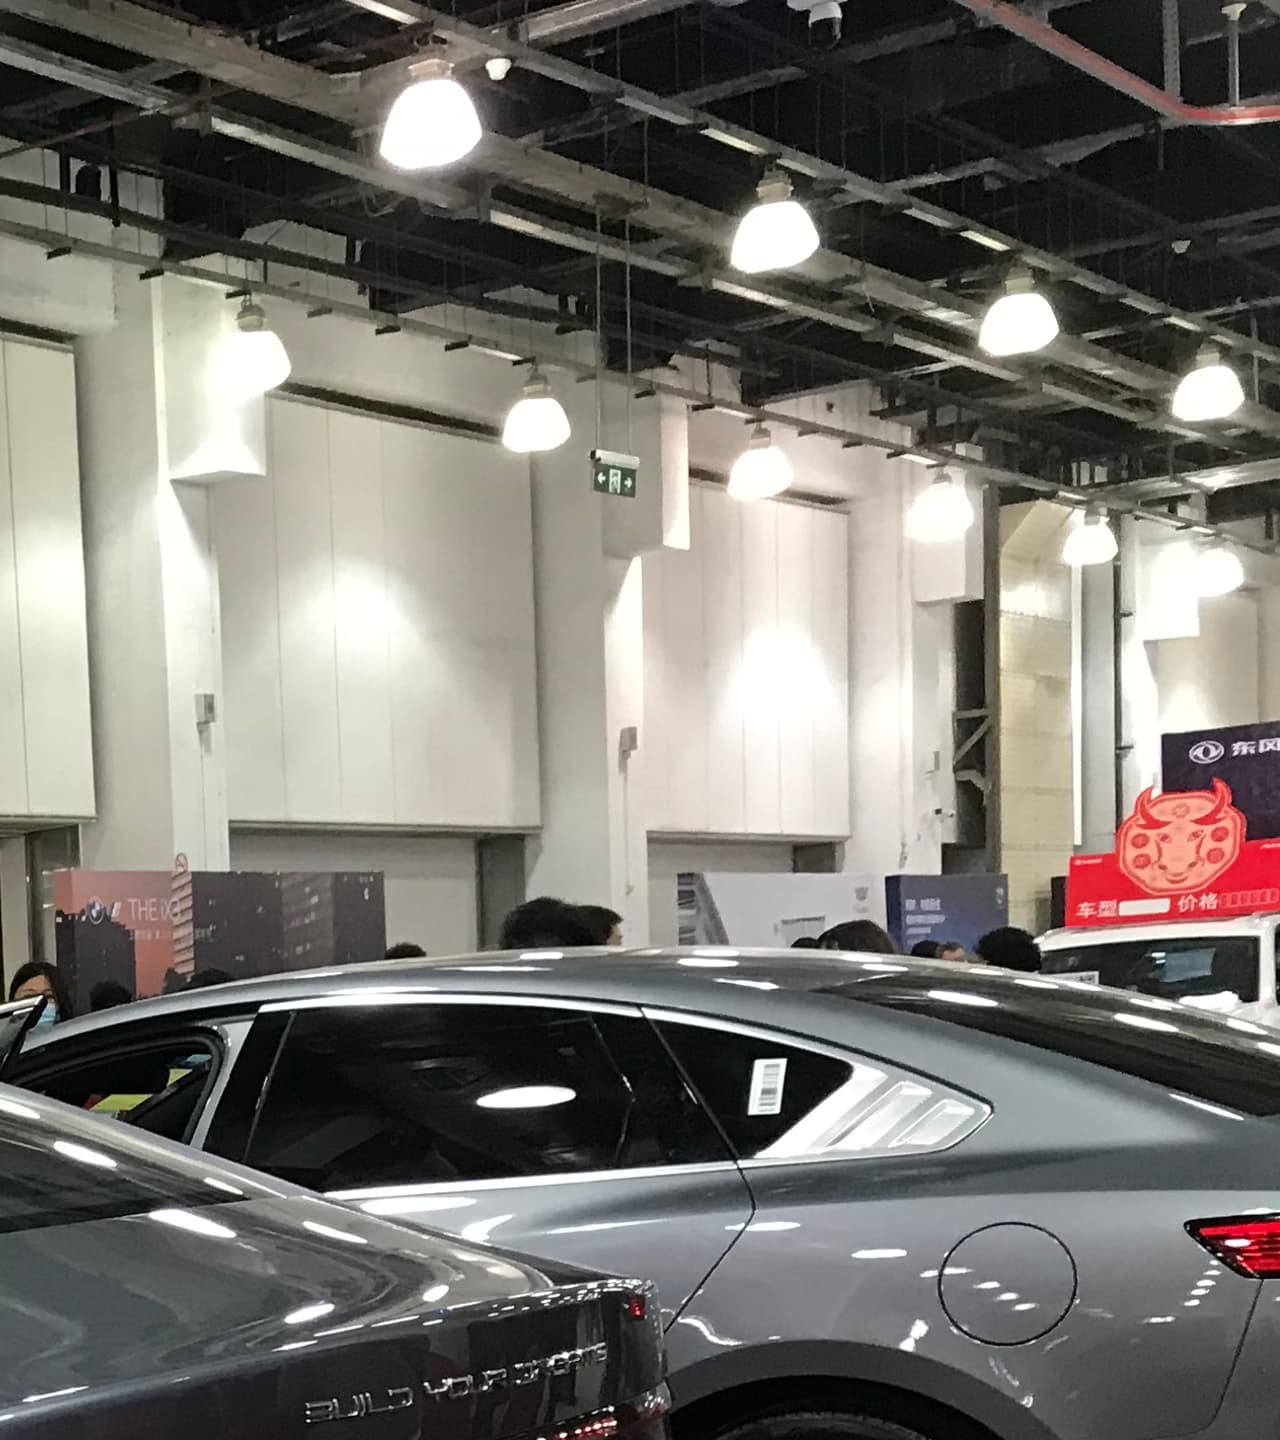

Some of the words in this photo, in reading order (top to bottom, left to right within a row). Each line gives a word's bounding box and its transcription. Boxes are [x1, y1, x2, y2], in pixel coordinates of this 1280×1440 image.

[128, 899, 158, 921] THE
[1077, 900, 1117, 918] 车型
[1178, 893, 1218, 912] 价格
[304, 1387, 414, 1424] BUILD
[423, 1368, 507, 1400] YOUR
